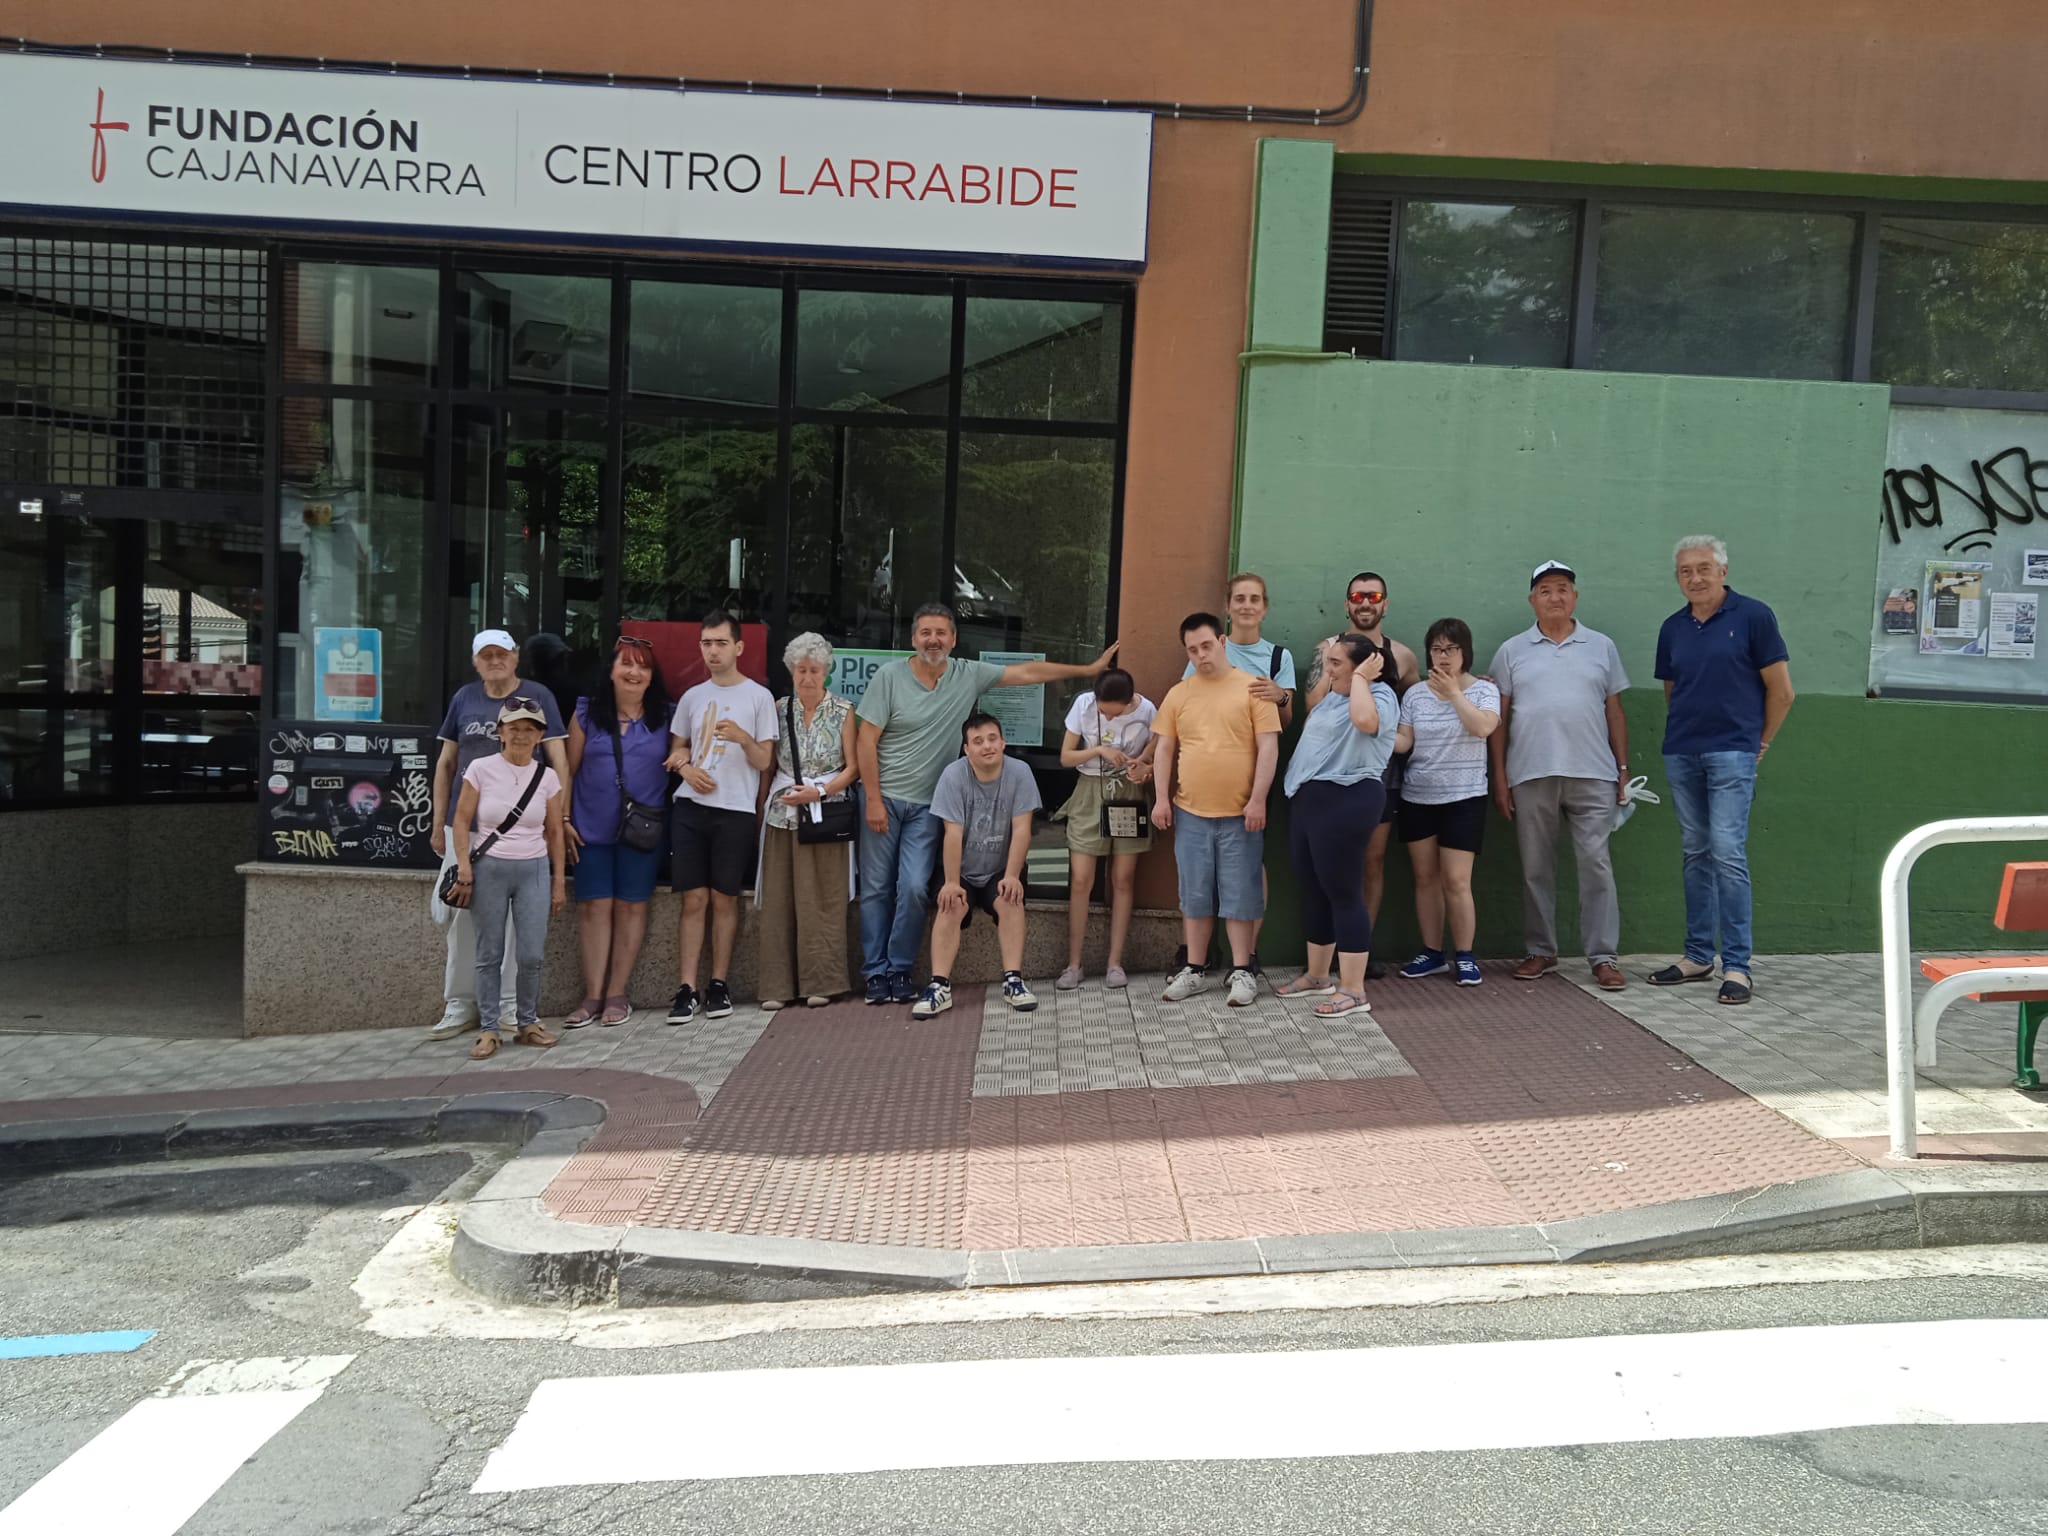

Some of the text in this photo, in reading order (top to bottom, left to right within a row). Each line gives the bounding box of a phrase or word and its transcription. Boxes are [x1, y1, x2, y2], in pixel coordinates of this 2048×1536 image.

[148, 104, 418, 153] FUNDACIÓN
[146, 145, 486, 197] CAJANAVARRA
[544, 144, 1078, 209] CENTRO LARRABIDE
